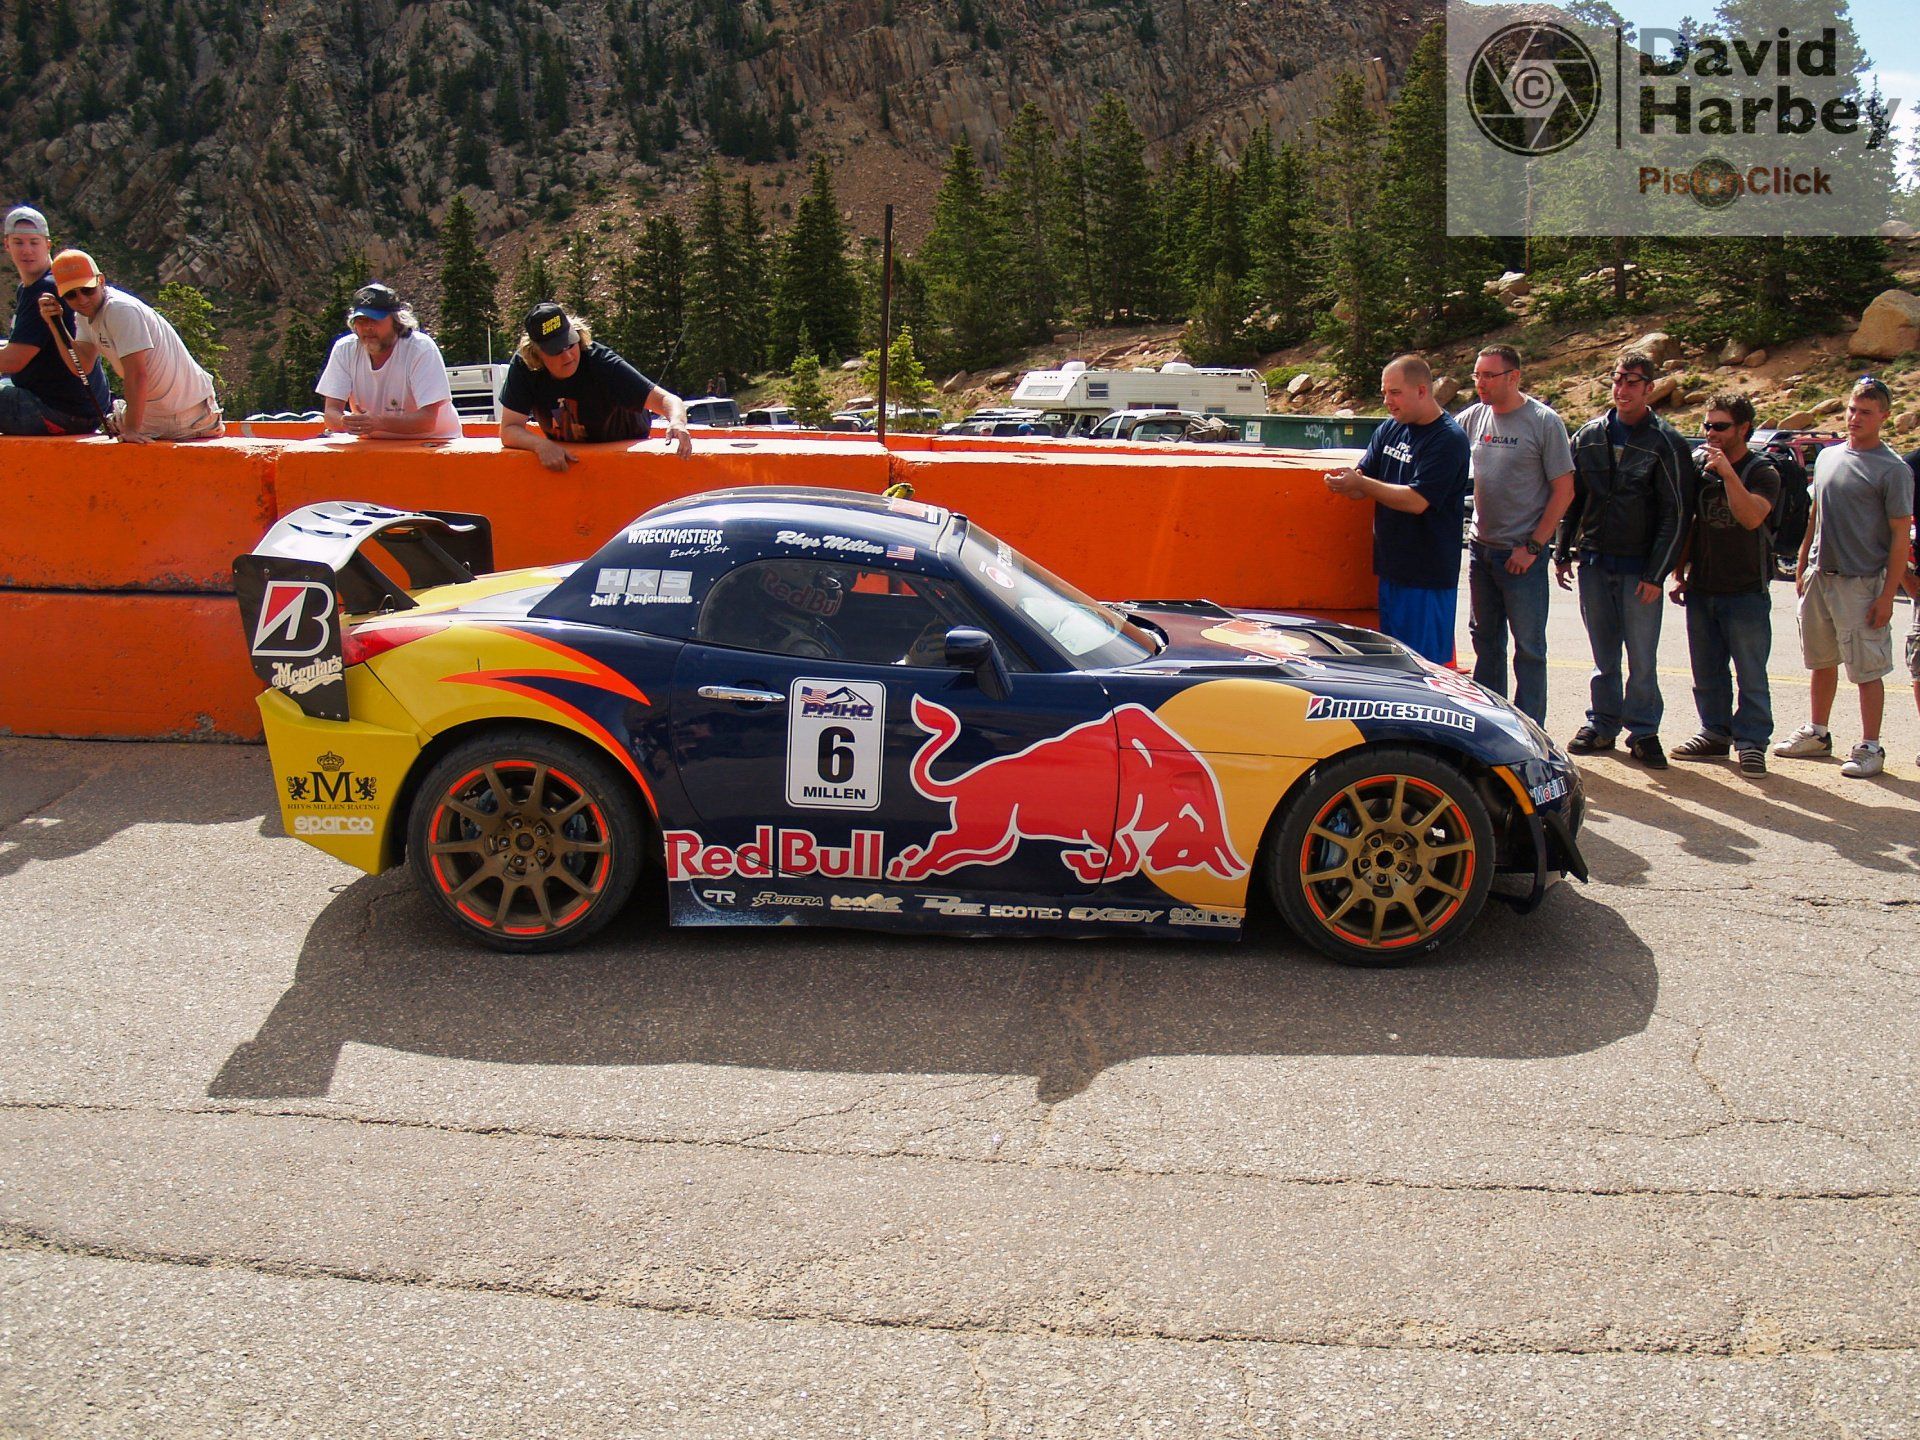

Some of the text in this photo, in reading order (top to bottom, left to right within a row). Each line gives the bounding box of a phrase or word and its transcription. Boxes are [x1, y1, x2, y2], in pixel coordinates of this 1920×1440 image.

[628, 528, 724, 545] WRECKMASTERS
[775, 530, 821, 549] Rhys
[669, 544, 730, 559] Body Shop
[596, 569, 692, 593] HKS
[590, 591, 693, 608] Drift Performance
[1306, 696, 1475, 732] BRIDGESTONE
[817, 726, 855, 784] 6
[307, 771, 357, 803] M
[803, 786, 866, 800] MILLEN
[663, 825, 885, 881] Red Bull
[989, 904, 1063, 919] ECOTEC
[1169, 907, 1241, 928] sparco
